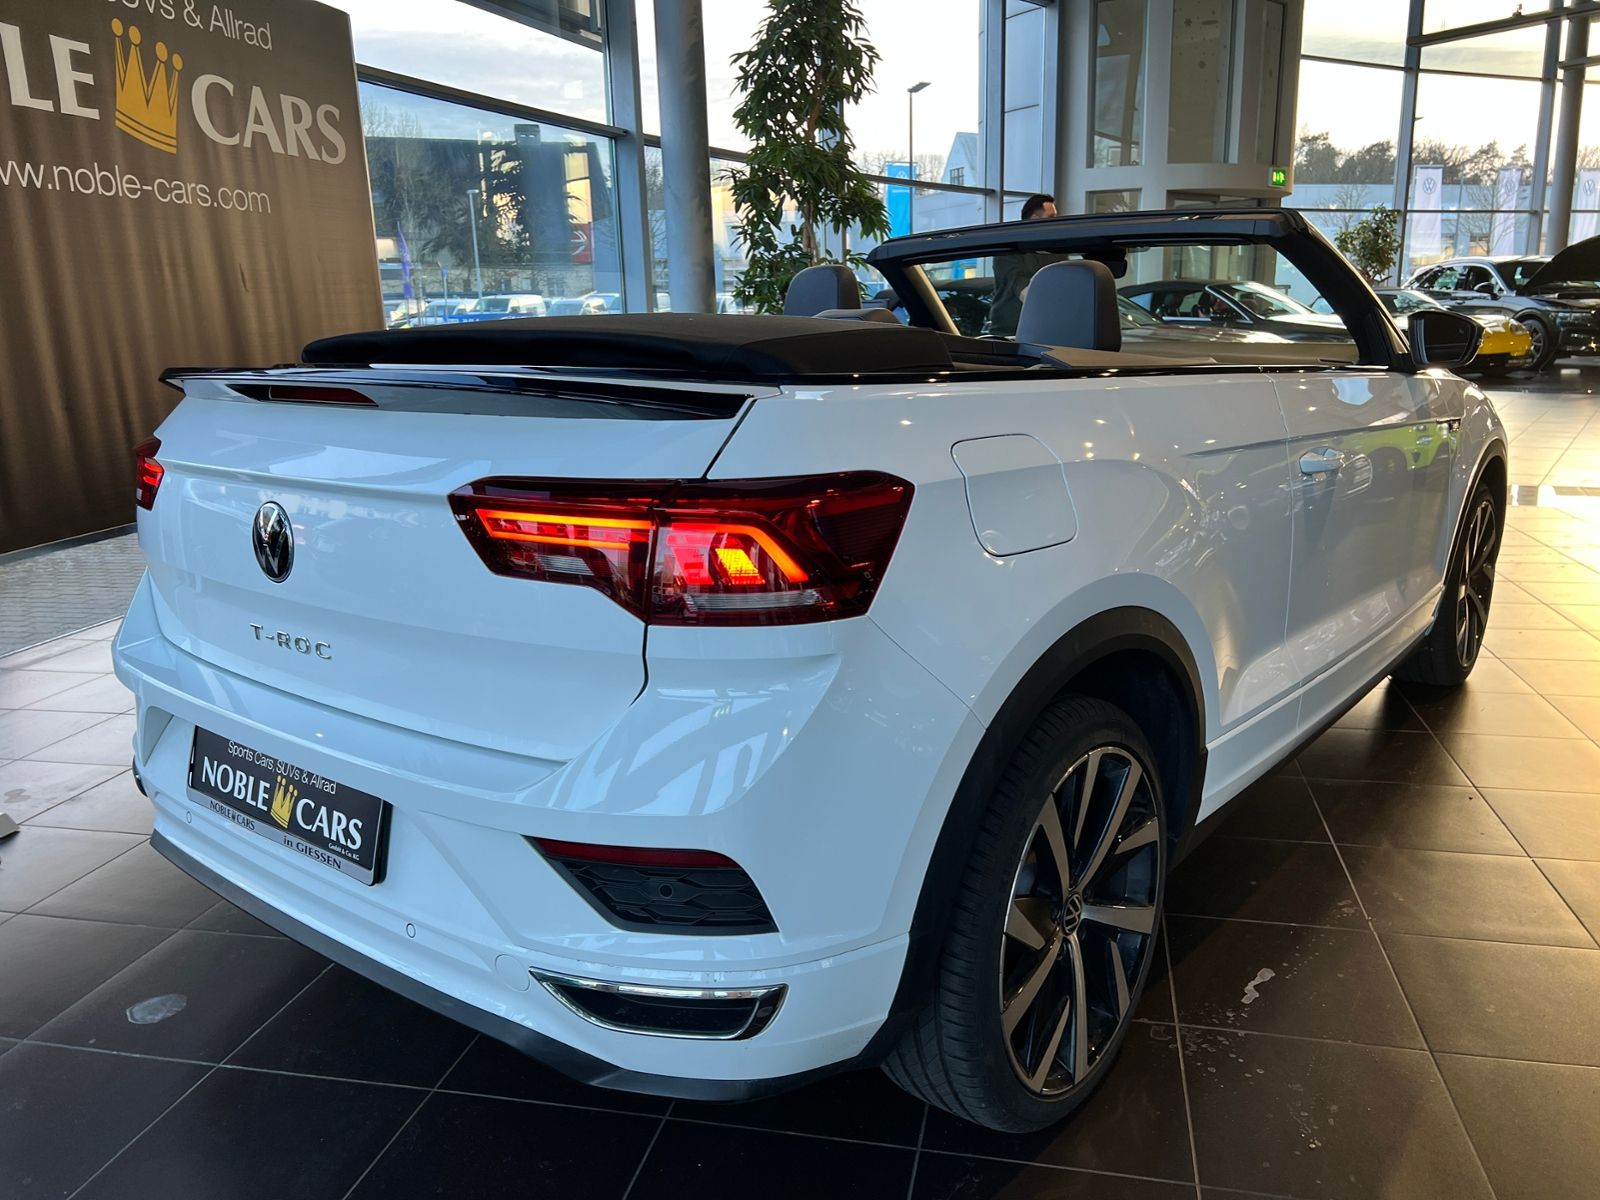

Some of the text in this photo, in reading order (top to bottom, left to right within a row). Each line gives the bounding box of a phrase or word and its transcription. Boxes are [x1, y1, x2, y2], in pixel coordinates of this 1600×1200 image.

[183, 0, 204, 29] &
[209, 5, 272, 50] Allrad
[191, 74, 346, 165] CARS
[250, 622, 332, 660] T-ROC
[228, 740, 337, 795] Sports Cars, SUVs & Allrad
[201, 756, 363, 850] NOBLE CARS
[209, 800, 256, 831] NOBLE CARS
[283, 835, 342, 869] in GIESSEN
